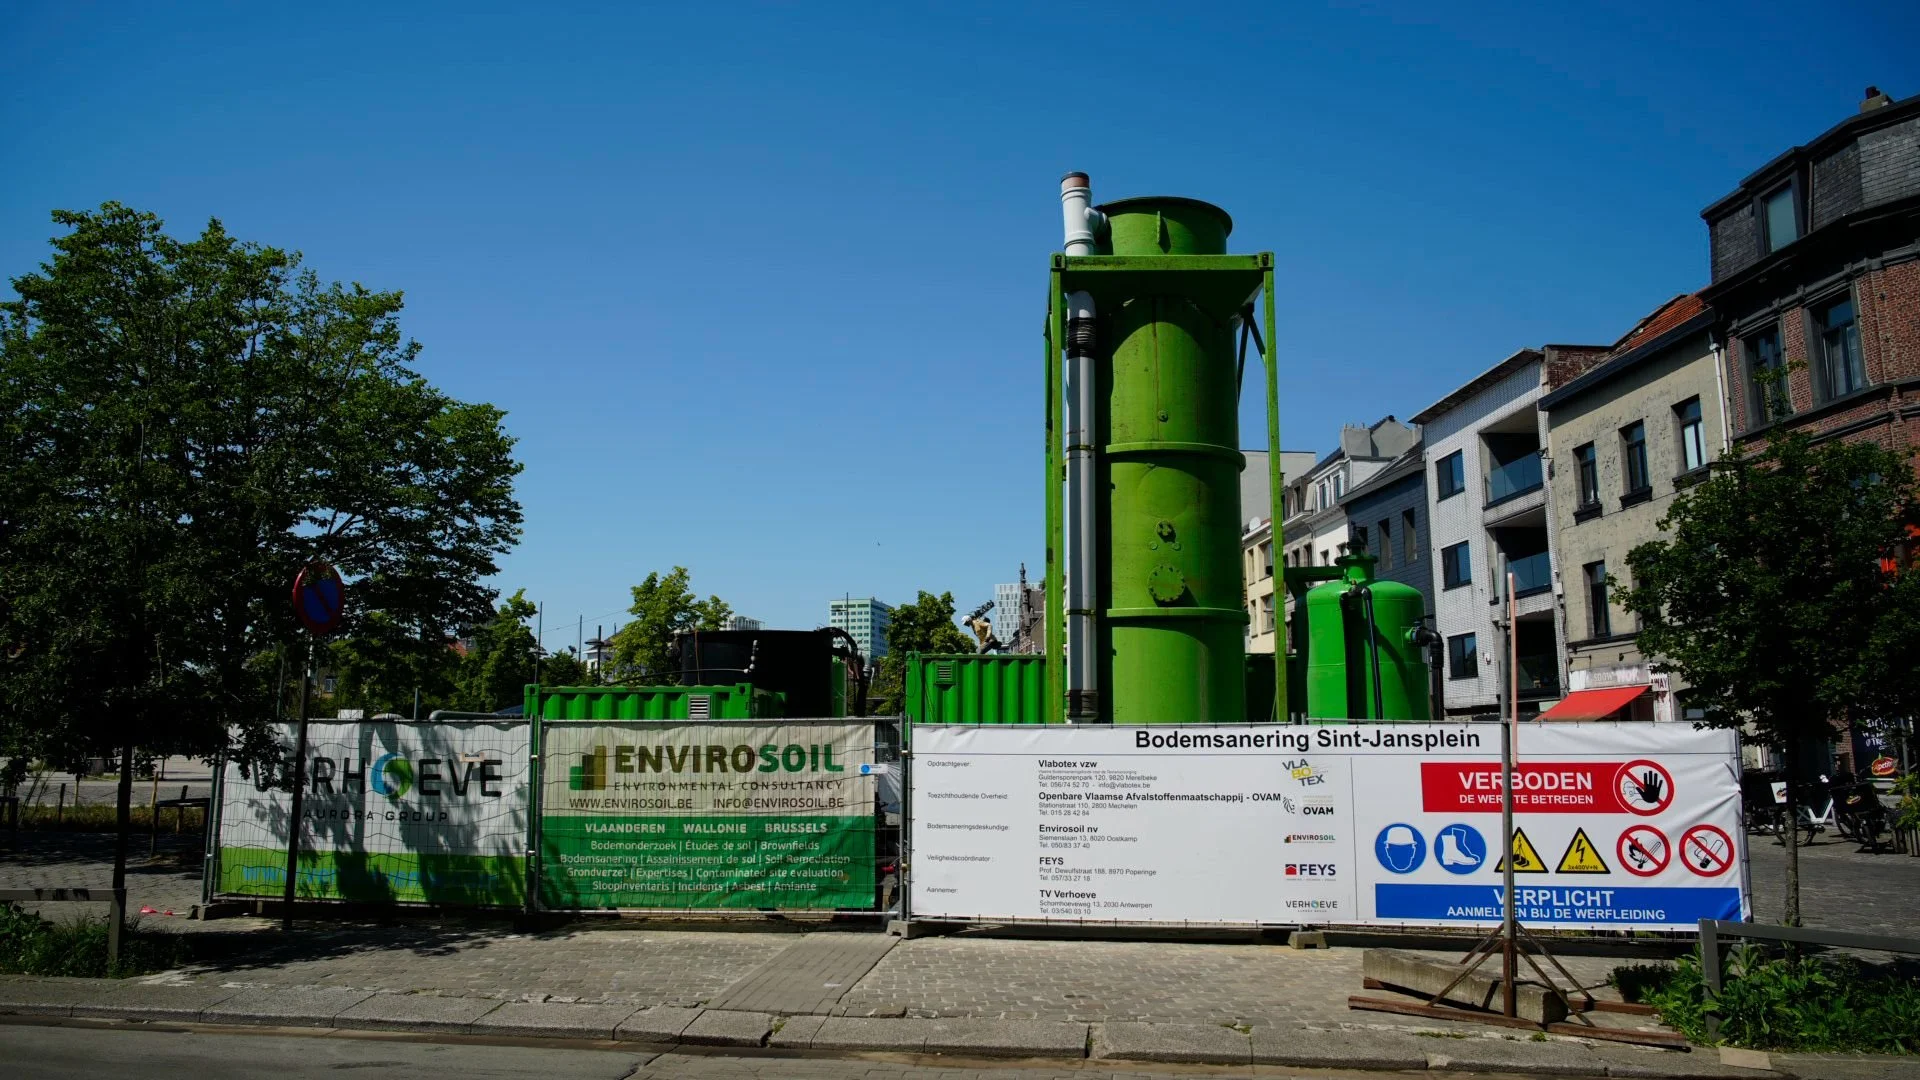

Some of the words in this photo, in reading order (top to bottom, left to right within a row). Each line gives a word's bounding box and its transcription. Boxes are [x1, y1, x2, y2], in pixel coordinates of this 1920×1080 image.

[1135, 730, 1309, 750] Bodemsanering
[1317, 730, 1480, 751] Sint-Jansplein
[615, 744, 844, 773] ENVIROSOIL
[1039, 760, 1077, 768] Vlabotex
[1282, 758, 1309, 770] VLA
[1292, 767, 1312, 779] BO
[614, 781, 734, 791] ENVIRONMENTAL
[742, 780, 842, 791] CONSULTANCY
[1298, 774, 1325, 787] TEX
[1458, 772, 1593, 790] VERBODEN
[569, 798, 693, 809] WWW.ENVIROSOIL.BE
[713, 797, 844, 809] INFO@ENVIROSOIL.BE
[1038, 792, 1082, 801] Openbare
[1085, 792, 1123, 800] Vlaamse
[1126, 792, 1243, 803] Afvalstoffenmaatschappij
[1252, 793, 1281, 801] OVAM
[1459, 795, 1475, 804] DE
[1478, 795, 1503, 804] WER
[1513, 795, 1528, 804] TE
[1531, 795, 1594, 804] BETREDEN
[303, 809, 374, 821] AURORA
[385, 811, 448, 822] GROUP
[1303, 806, 1334, 815] OVAM
[585, 823, 666, 833] VLAANDEREN
[683, 823, 747, 833] WALLONIE
[765, 823, 828, 833] BRUSSELS
[1039, 824, 1085, 833] Envirosoil
[590, 840, 677, 850] Bodemonderzoek
[685, 840, 719, 850] Études
[723, 841, 734, 850] de
[737, 841, 751, 850] sol
[760, 841, 820, 850] Brownfields
[560, 854, 638, 866] Bodemsanering
[646, 855, 722, 864] Assainissement
[726, 855, 739, 864] de
[741, 855, 756, 864] sol
[765, 855, 783, 864] Soil
[786, 855, 851, 864] Remediation
[1039, 857, 1064, 865] FEYS
[567, 867, 628, 877] Grondverzet
[636, 868, 688, 879] Expertises
[696, 868, 766, 878] Contaminated
[769, 868, 788, 877] site
[790, 868, 844, 878] evaluation
[1299, 864, 1336, 876] FEYS
[592, 881, 670, 892] Sloopinventaris
[678, 881, 723, 891] Incidents
[732, 882, 765, 891] Asbest
[774, 882, 817, 891] Amiante
[1039, 890, 1052, 898] TV
[1054, 890, 1097, 899] Verhoeve
[1493, 889, 1615, 907] VERPLICHT
[1286, 900, 1338, 909] VERHOEVE
[1531, 908, 1550, 919] BIJ
[1554, 908, 1571, 919] DE
[1576, 909, 1666, 920] WERFLEIDING
